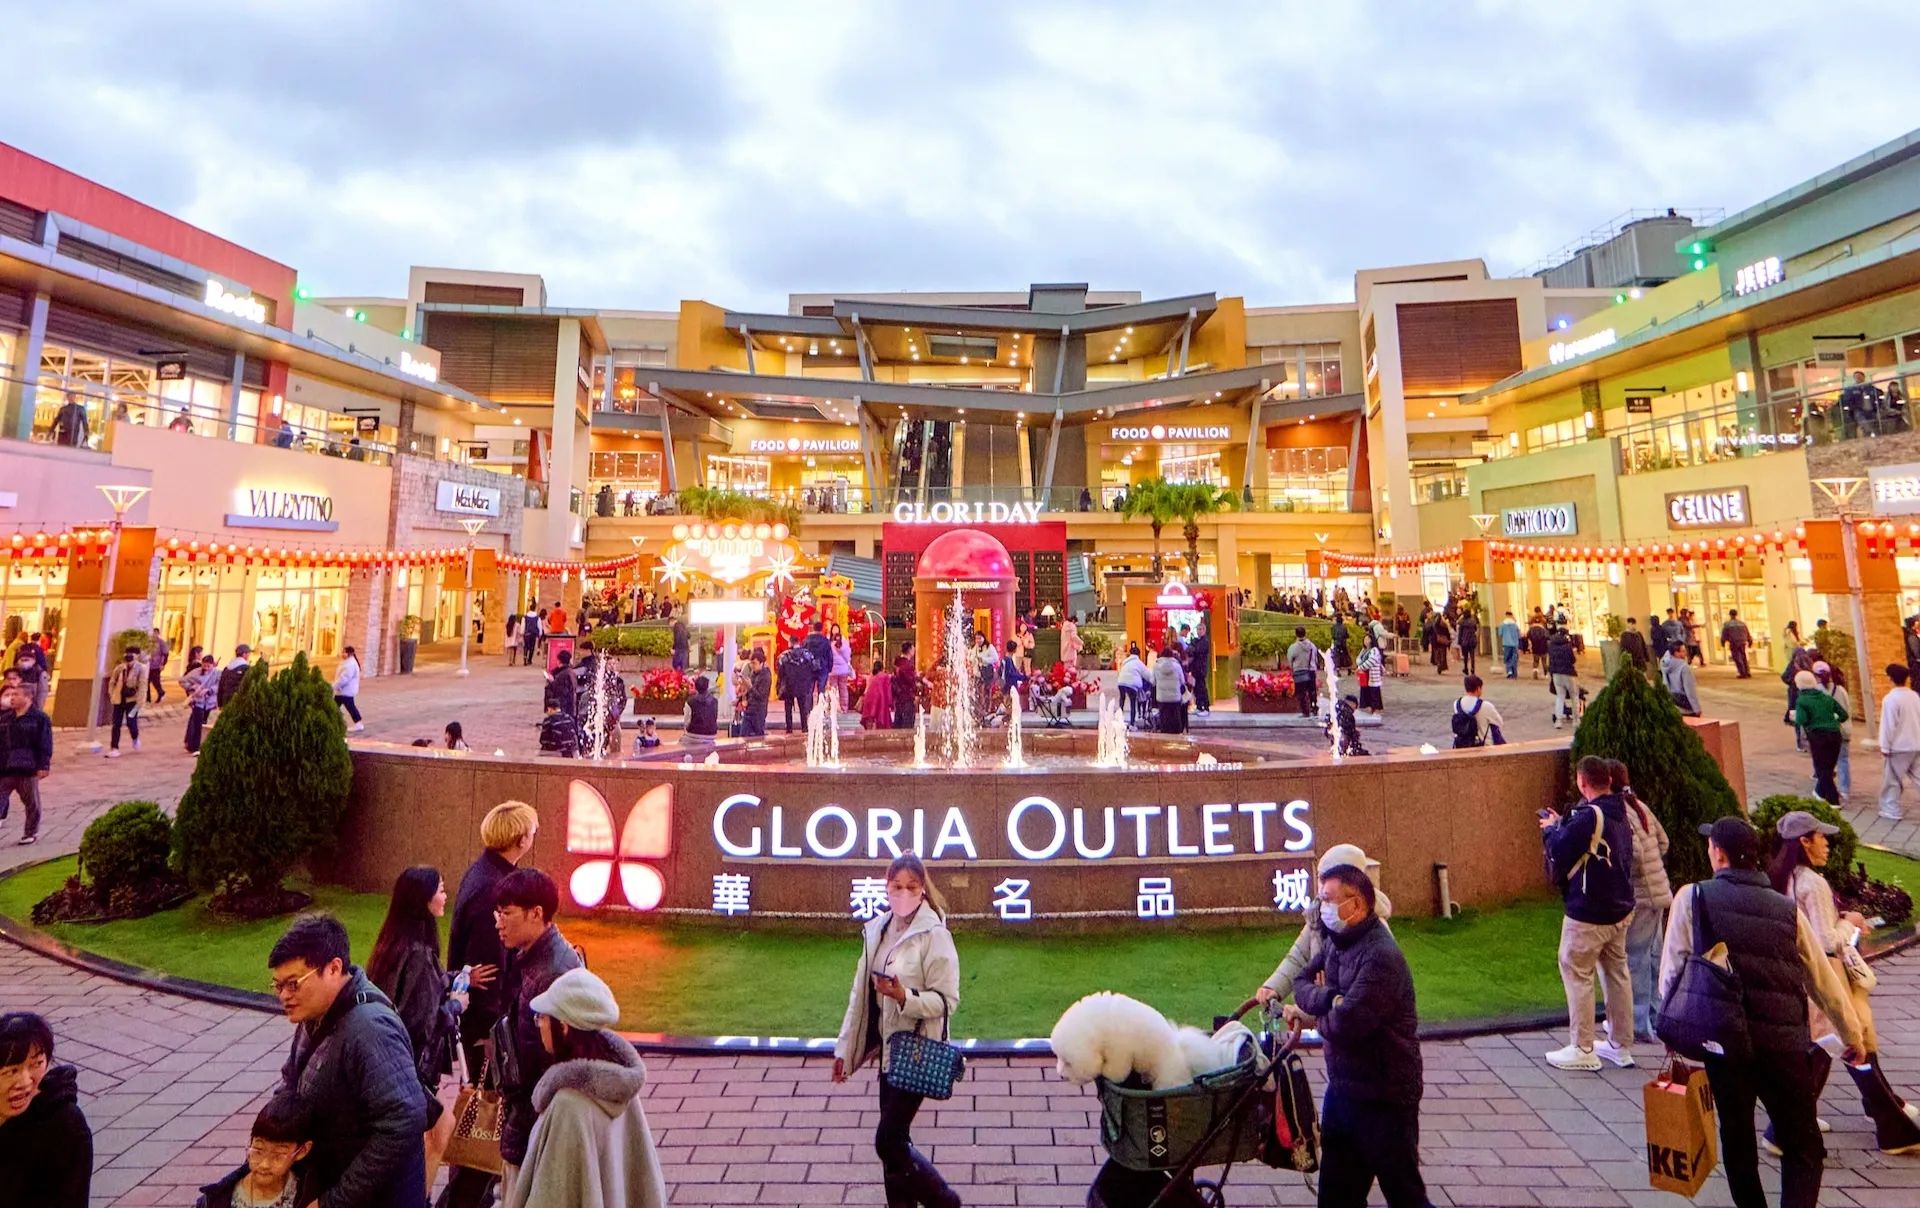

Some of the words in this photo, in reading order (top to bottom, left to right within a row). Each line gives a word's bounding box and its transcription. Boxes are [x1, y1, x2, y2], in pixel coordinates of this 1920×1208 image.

[1112, 428, 1149, 439] FOOD
[1168, 427, 1229, 438] PAVILION
[751, 440, 785, 450] FOOD
[803, 440, 859, 450] PAVILION
[250, 489, 333, 521] VALENTINO
[712, 793, 978, 858] GLORIA
[1006, 796, 1313, 859] OUTLETS
